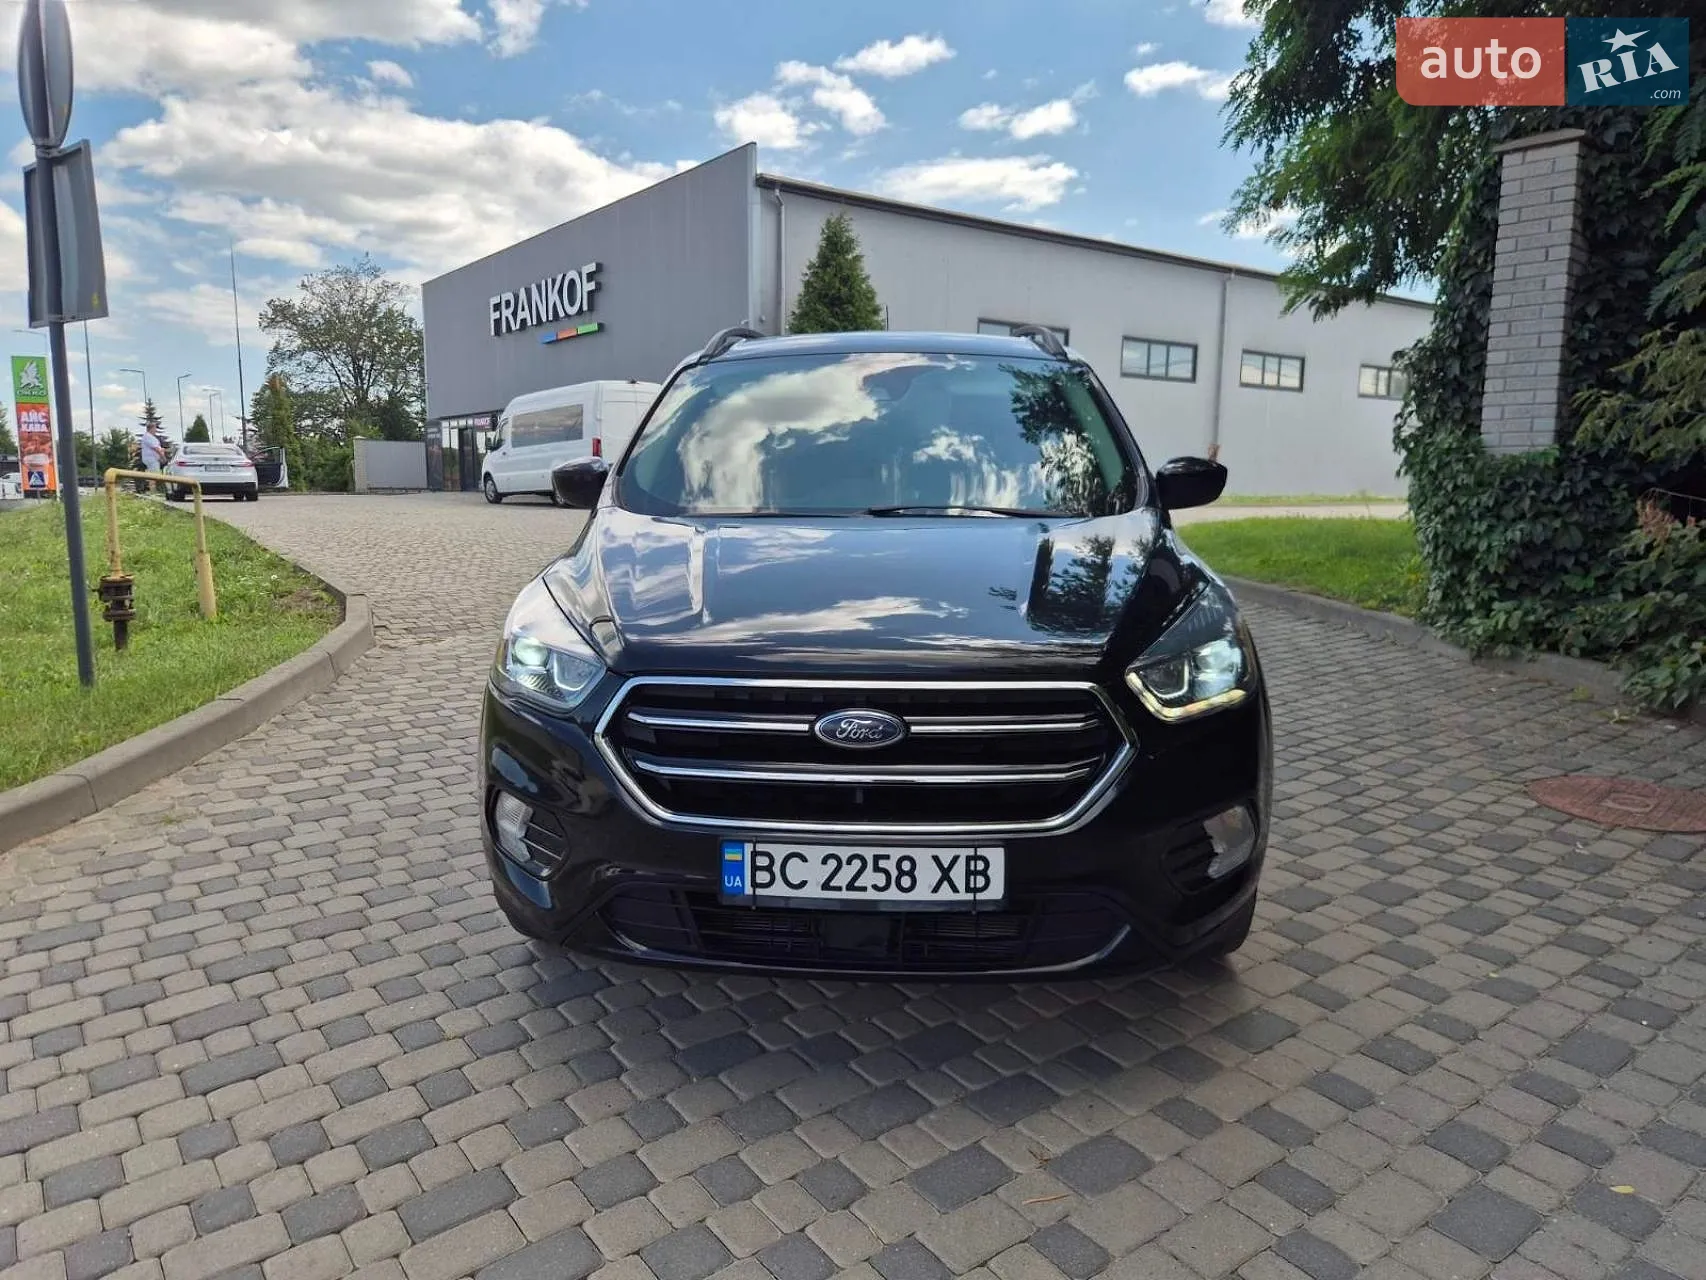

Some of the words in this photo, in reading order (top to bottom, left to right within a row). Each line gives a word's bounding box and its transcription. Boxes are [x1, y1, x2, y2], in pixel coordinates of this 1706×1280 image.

[489, 261, 598, 336] FRANKOF
[836, 718, 884, 739] Ford
[724, 875, 743, 888] UA
[750, 850, 809, 890] BC
[820, 853, 918, 893] 2258
[931, 854, 991, 894] XB
